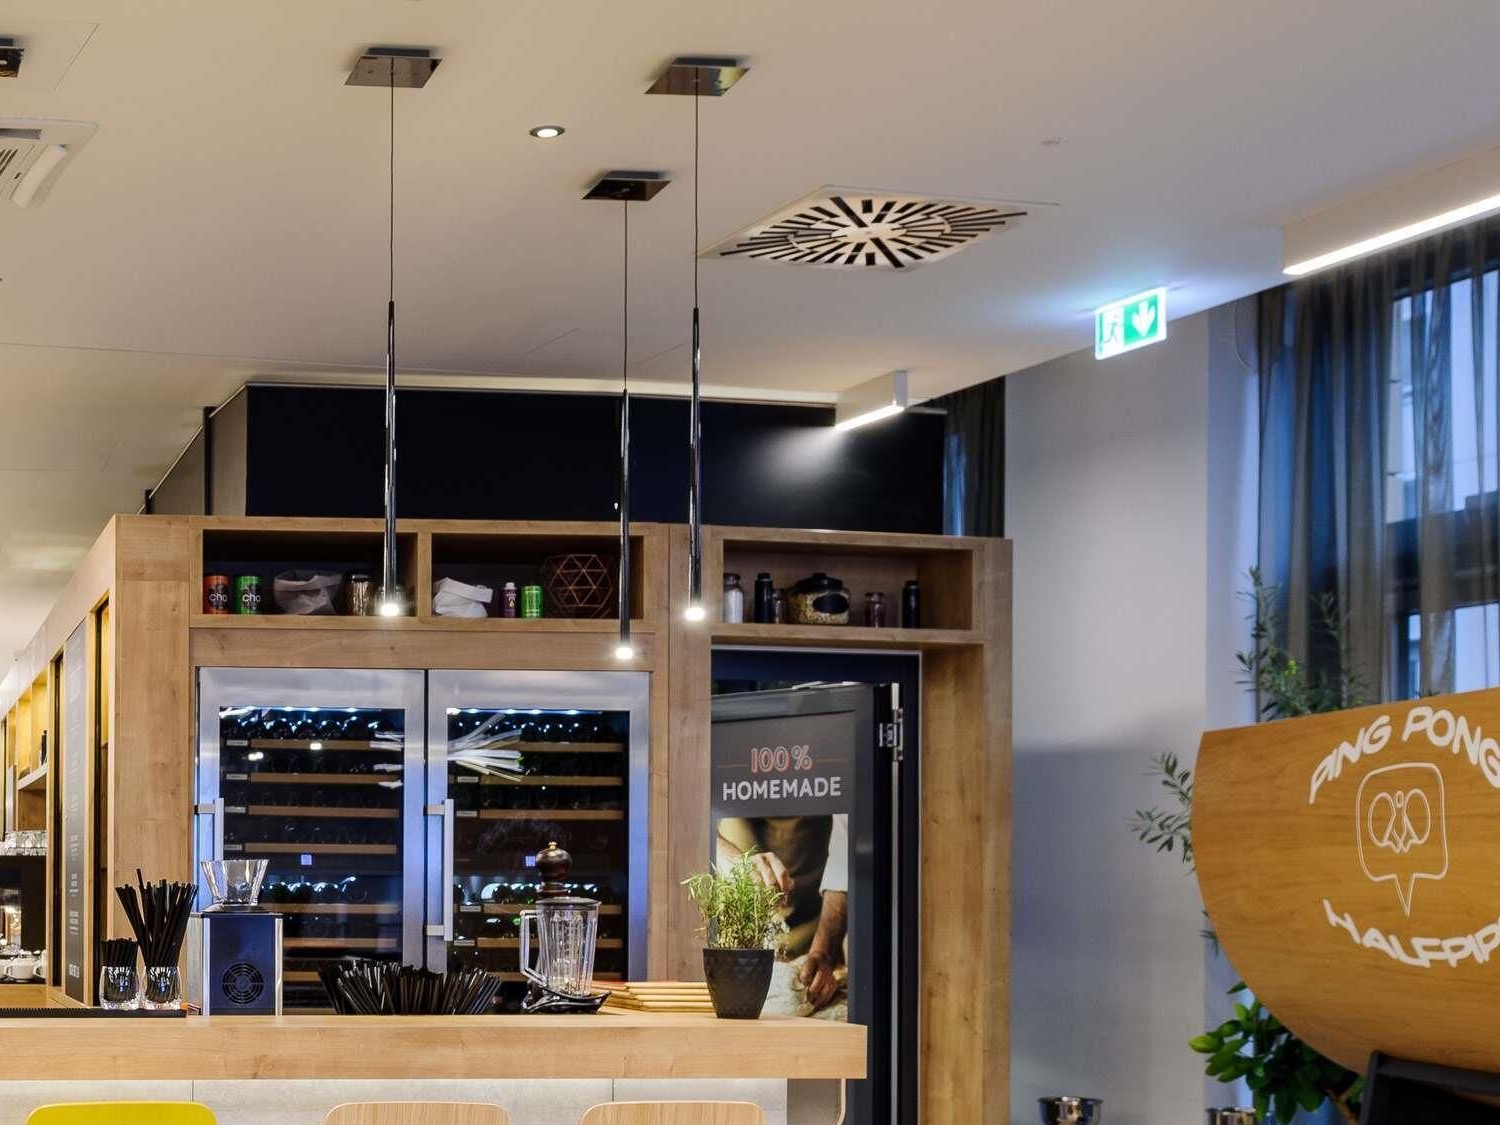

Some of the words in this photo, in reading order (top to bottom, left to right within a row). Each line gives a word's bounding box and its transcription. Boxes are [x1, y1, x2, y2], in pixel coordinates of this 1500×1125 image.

[1401, 706, 1500, 789] PONG
[722, 776, 842, 801] HOMEMADE
[1322, 898, 1500, 969] HALFPIP
